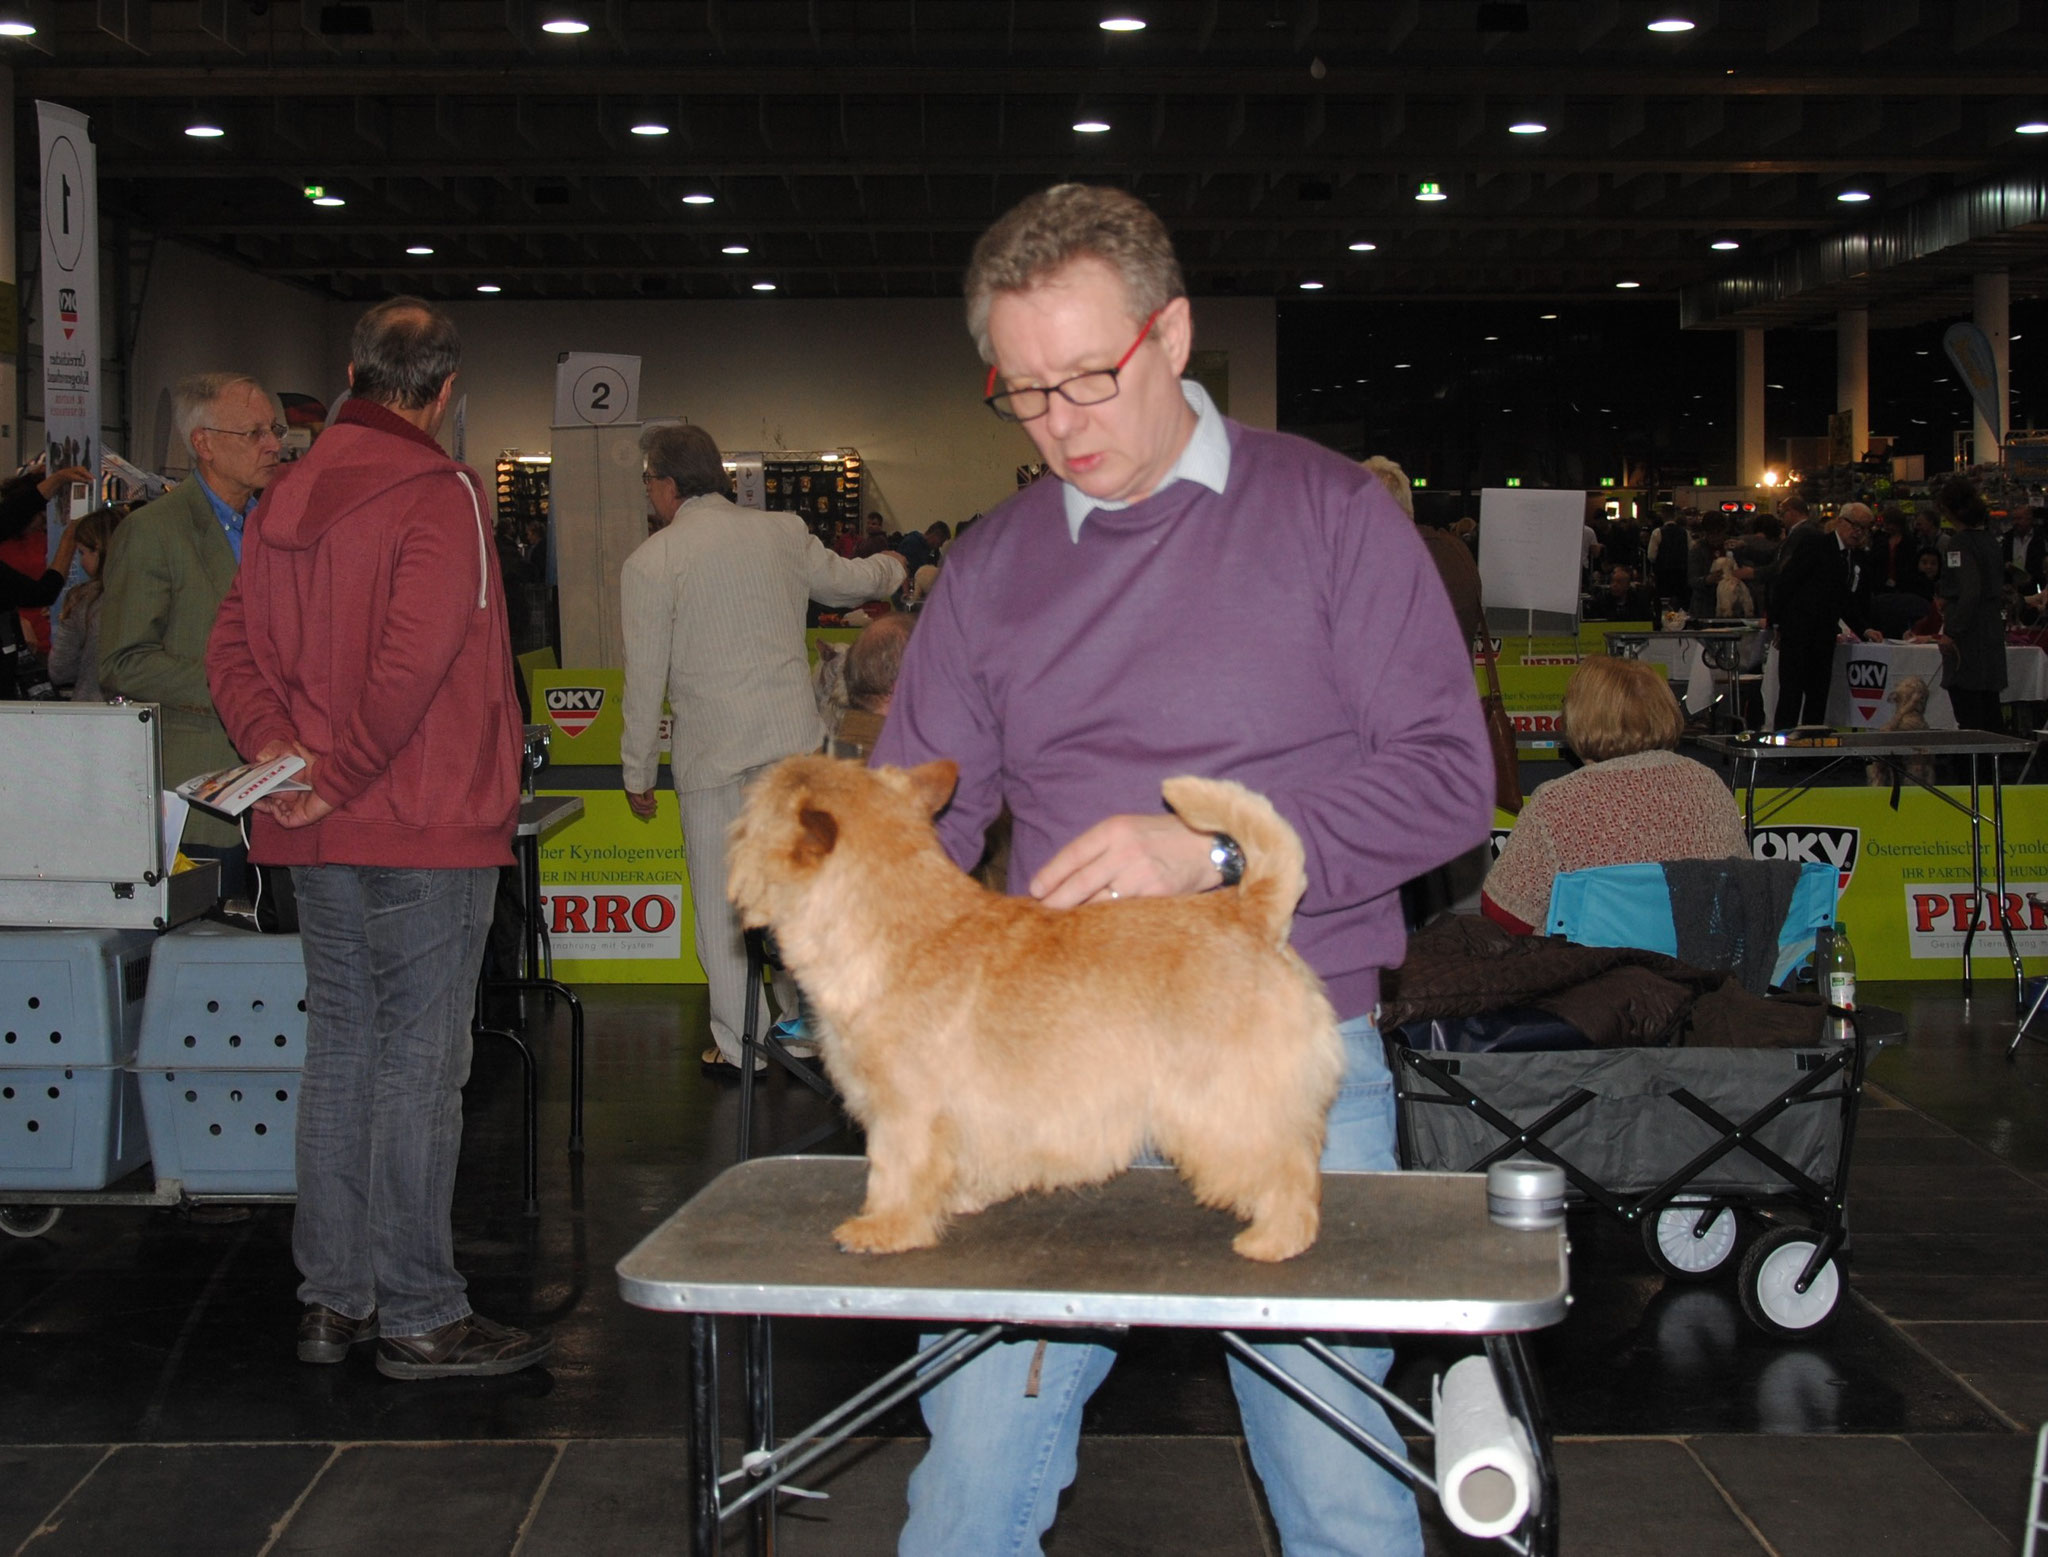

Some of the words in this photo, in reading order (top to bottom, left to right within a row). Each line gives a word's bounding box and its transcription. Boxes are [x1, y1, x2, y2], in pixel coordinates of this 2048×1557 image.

[590, 381, 610, 410] 2
[547, 690, 599, 709] ÖKV
[563, 871, 577, 882] IN
[580, 870, 684, 883] HUNDEFRAGEN
[1902, 867, 1925, 879] IHR
[1928, 866, 1987, 879] PARTNR
[601, 941, 616, 950] mit
[621, 940, 655, 952] System
